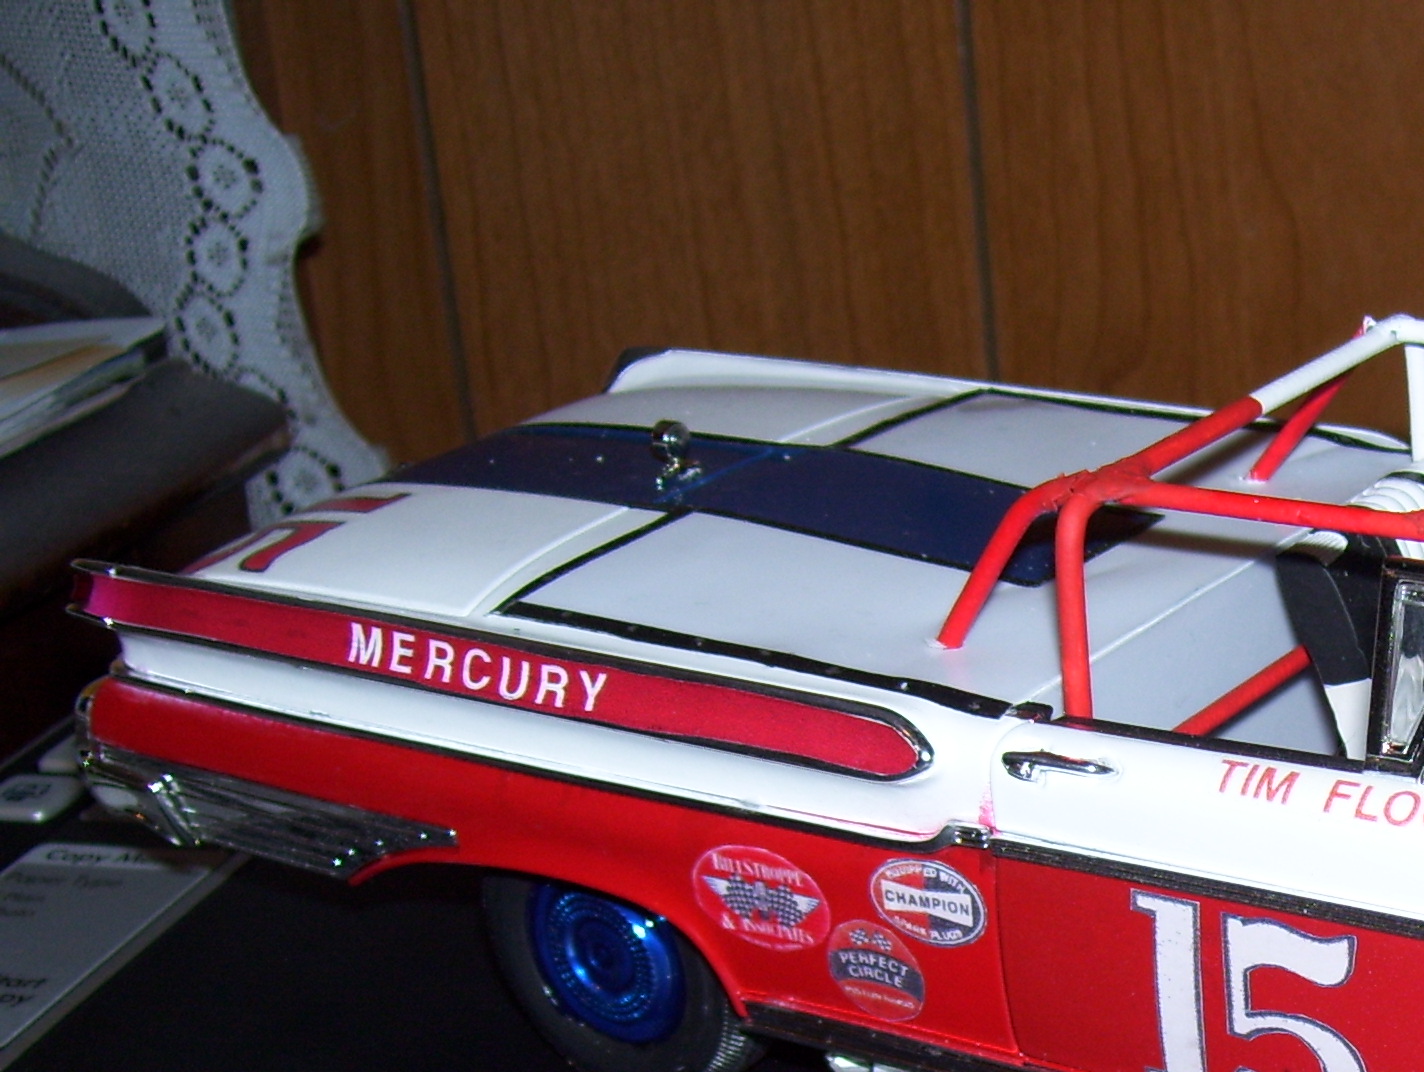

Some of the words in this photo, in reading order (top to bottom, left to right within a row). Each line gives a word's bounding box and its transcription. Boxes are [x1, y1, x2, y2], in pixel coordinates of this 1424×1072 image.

[347, 622, 608, 712] MERCURY
[1218, 759, 1300, 805] TIM
[885, 889, 970, 926] CHAMPION
[839, 951, 909, 977] PERFECT
[849, 964, 903, 988] CIRCLE
